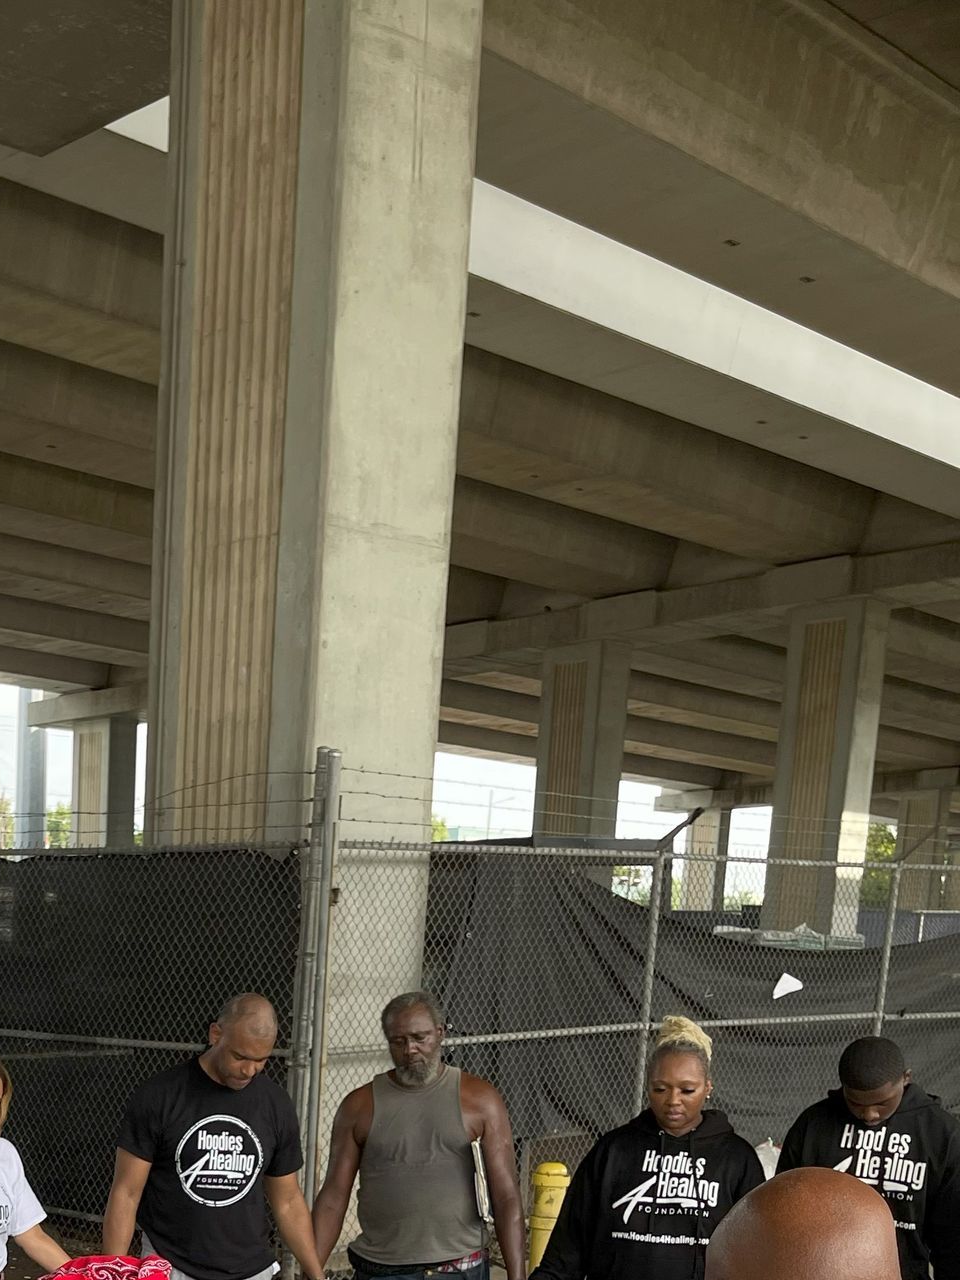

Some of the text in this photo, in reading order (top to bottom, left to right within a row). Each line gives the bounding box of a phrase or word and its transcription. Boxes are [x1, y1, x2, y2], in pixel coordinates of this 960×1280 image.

[197, 1130, 244, 1152] Hoodies
[840, 1124, 911, 1155] Hoodes
[180, 1149, 255, 1190] 4 Healing
[197, 1177, 246, 1185] FOUNDATION
